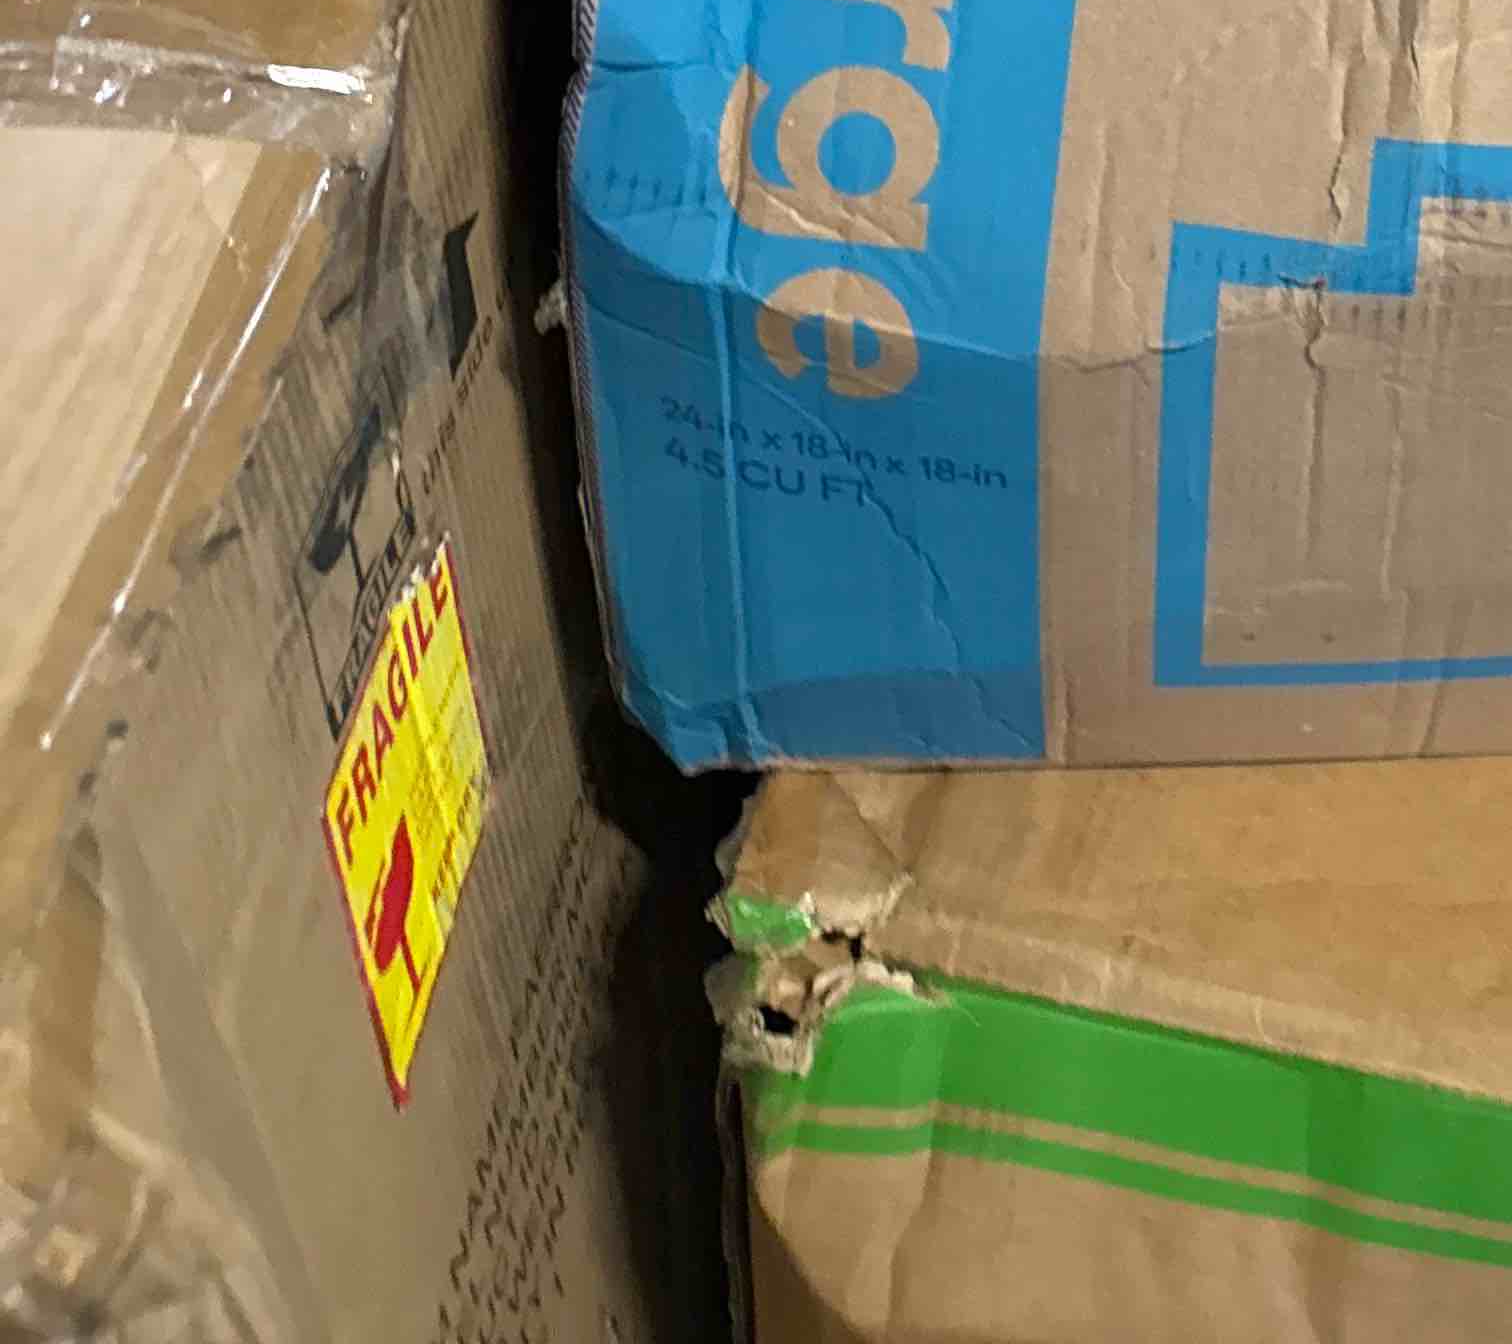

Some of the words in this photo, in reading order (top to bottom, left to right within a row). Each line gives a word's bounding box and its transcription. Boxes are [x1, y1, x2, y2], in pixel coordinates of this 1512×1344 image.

[737, 458, 806, 496] CU
[762, 428, 784, 451] x
[885, 456, 906, 475] x
[919, 456, 1009, 489] 18-in
[335, 566, 451, 866] FRAGILE
